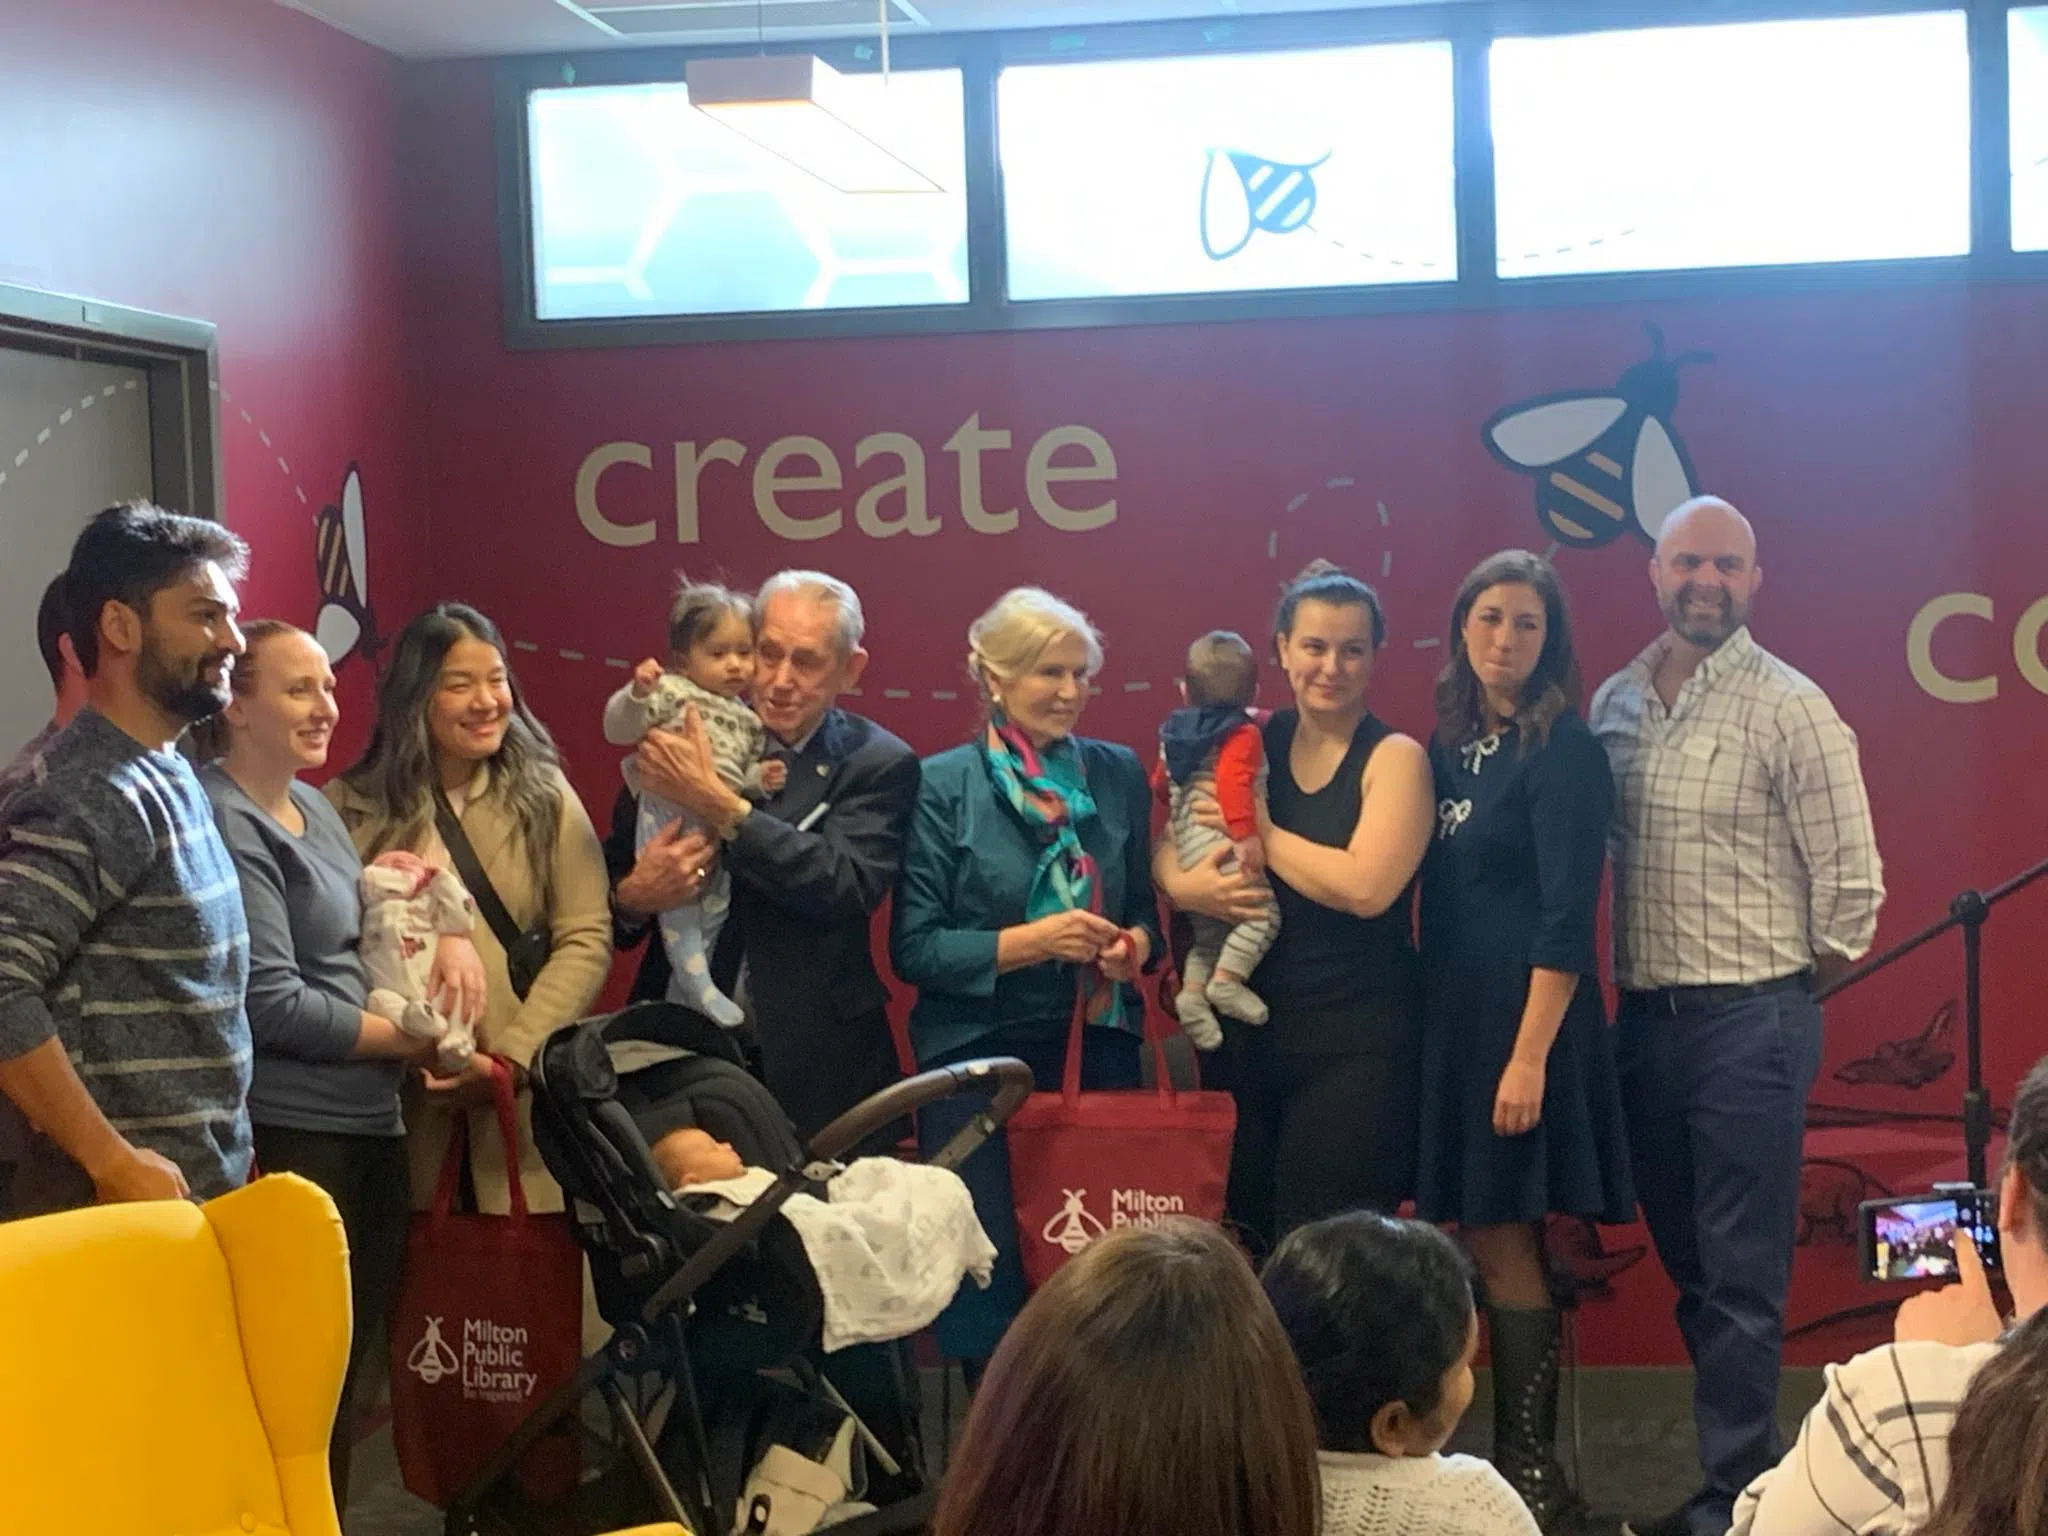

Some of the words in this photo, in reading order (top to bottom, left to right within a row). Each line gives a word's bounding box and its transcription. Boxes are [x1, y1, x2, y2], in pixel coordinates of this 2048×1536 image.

[574, 411, 1118, 547] create
[1112, 1188, 1184, 1212] Milton
[463, 1318, 528, 1344] Milton
[463, 1341, 524, 1367] Public
[463, 1363, 537, 1396] Library
